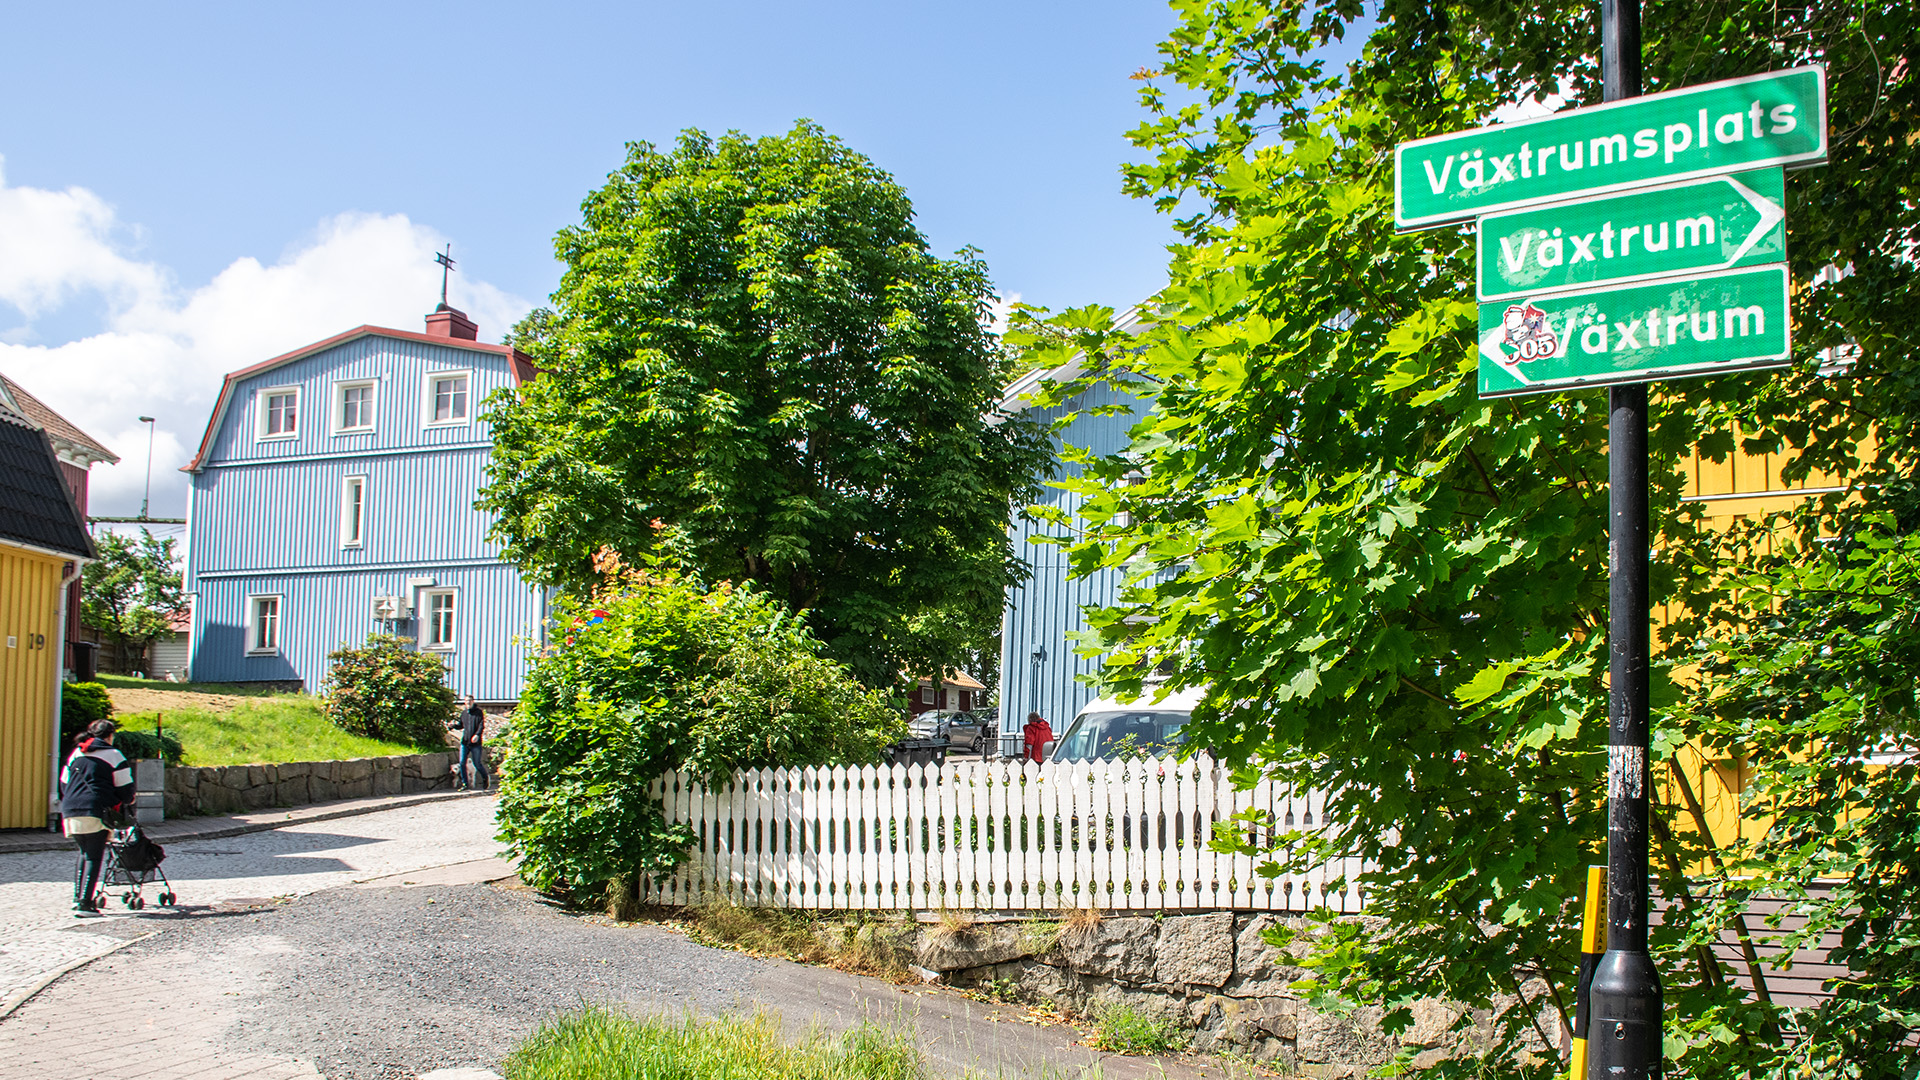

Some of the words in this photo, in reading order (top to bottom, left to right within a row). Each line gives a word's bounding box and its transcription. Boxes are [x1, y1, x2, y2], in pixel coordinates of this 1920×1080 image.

[1423, 99, 1797, 195] Växtrumsplats
[1499, 214, 1716, 273] Växtrum
[29, 633, 45, 650] 19
[1598, 885, 1607, 951] KABELSKÅP
